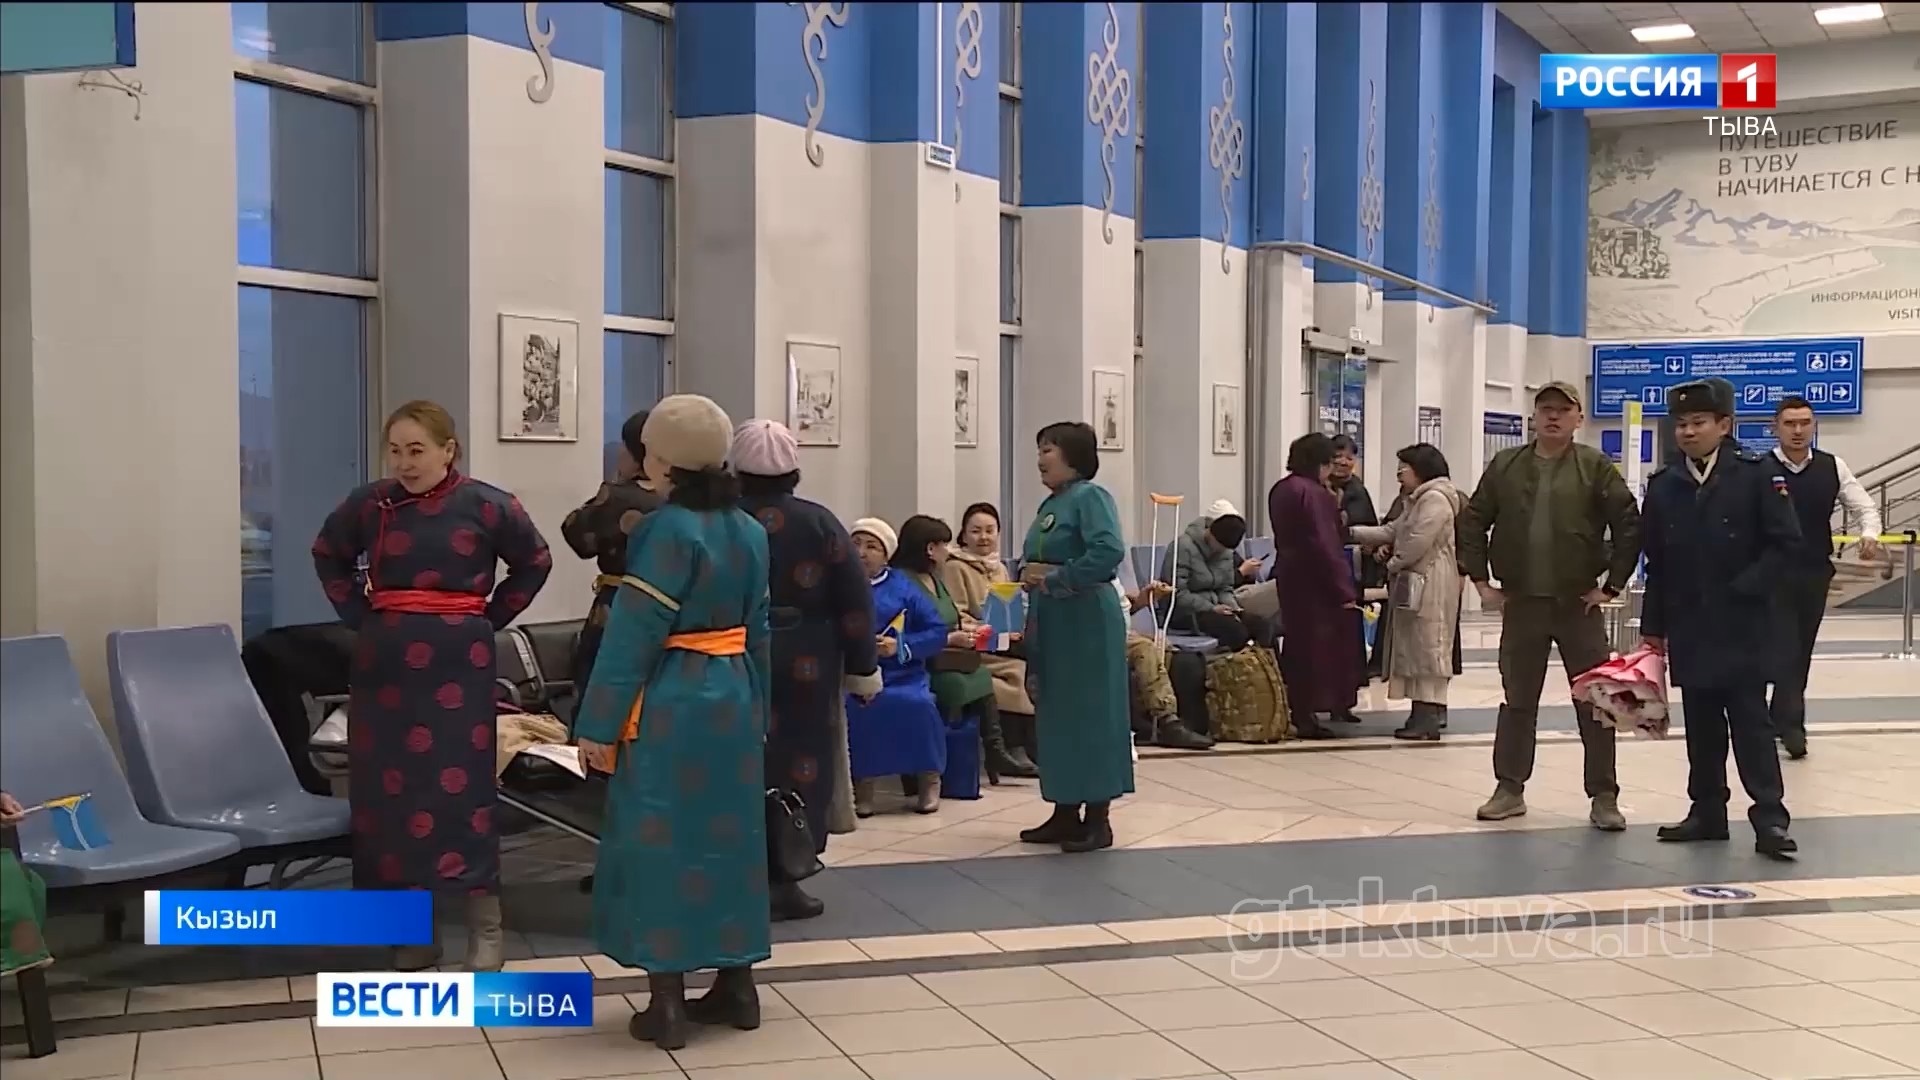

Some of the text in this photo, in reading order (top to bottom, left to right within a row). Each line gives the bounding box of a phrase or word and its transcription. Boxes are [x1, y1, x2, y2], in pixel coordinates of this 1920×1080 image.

[1719, 120, 1898, 152] ПУТЕШЕСТВИЕ
[1718, 152, 1799, 175] В ТУВУ
[1717, 169, 1872, 197] НАЧИНАЕТСЯ
[1881, 166, 1897, 186] С
[1811, 288, 1920, 303] ИНФОРМАЦИОН
